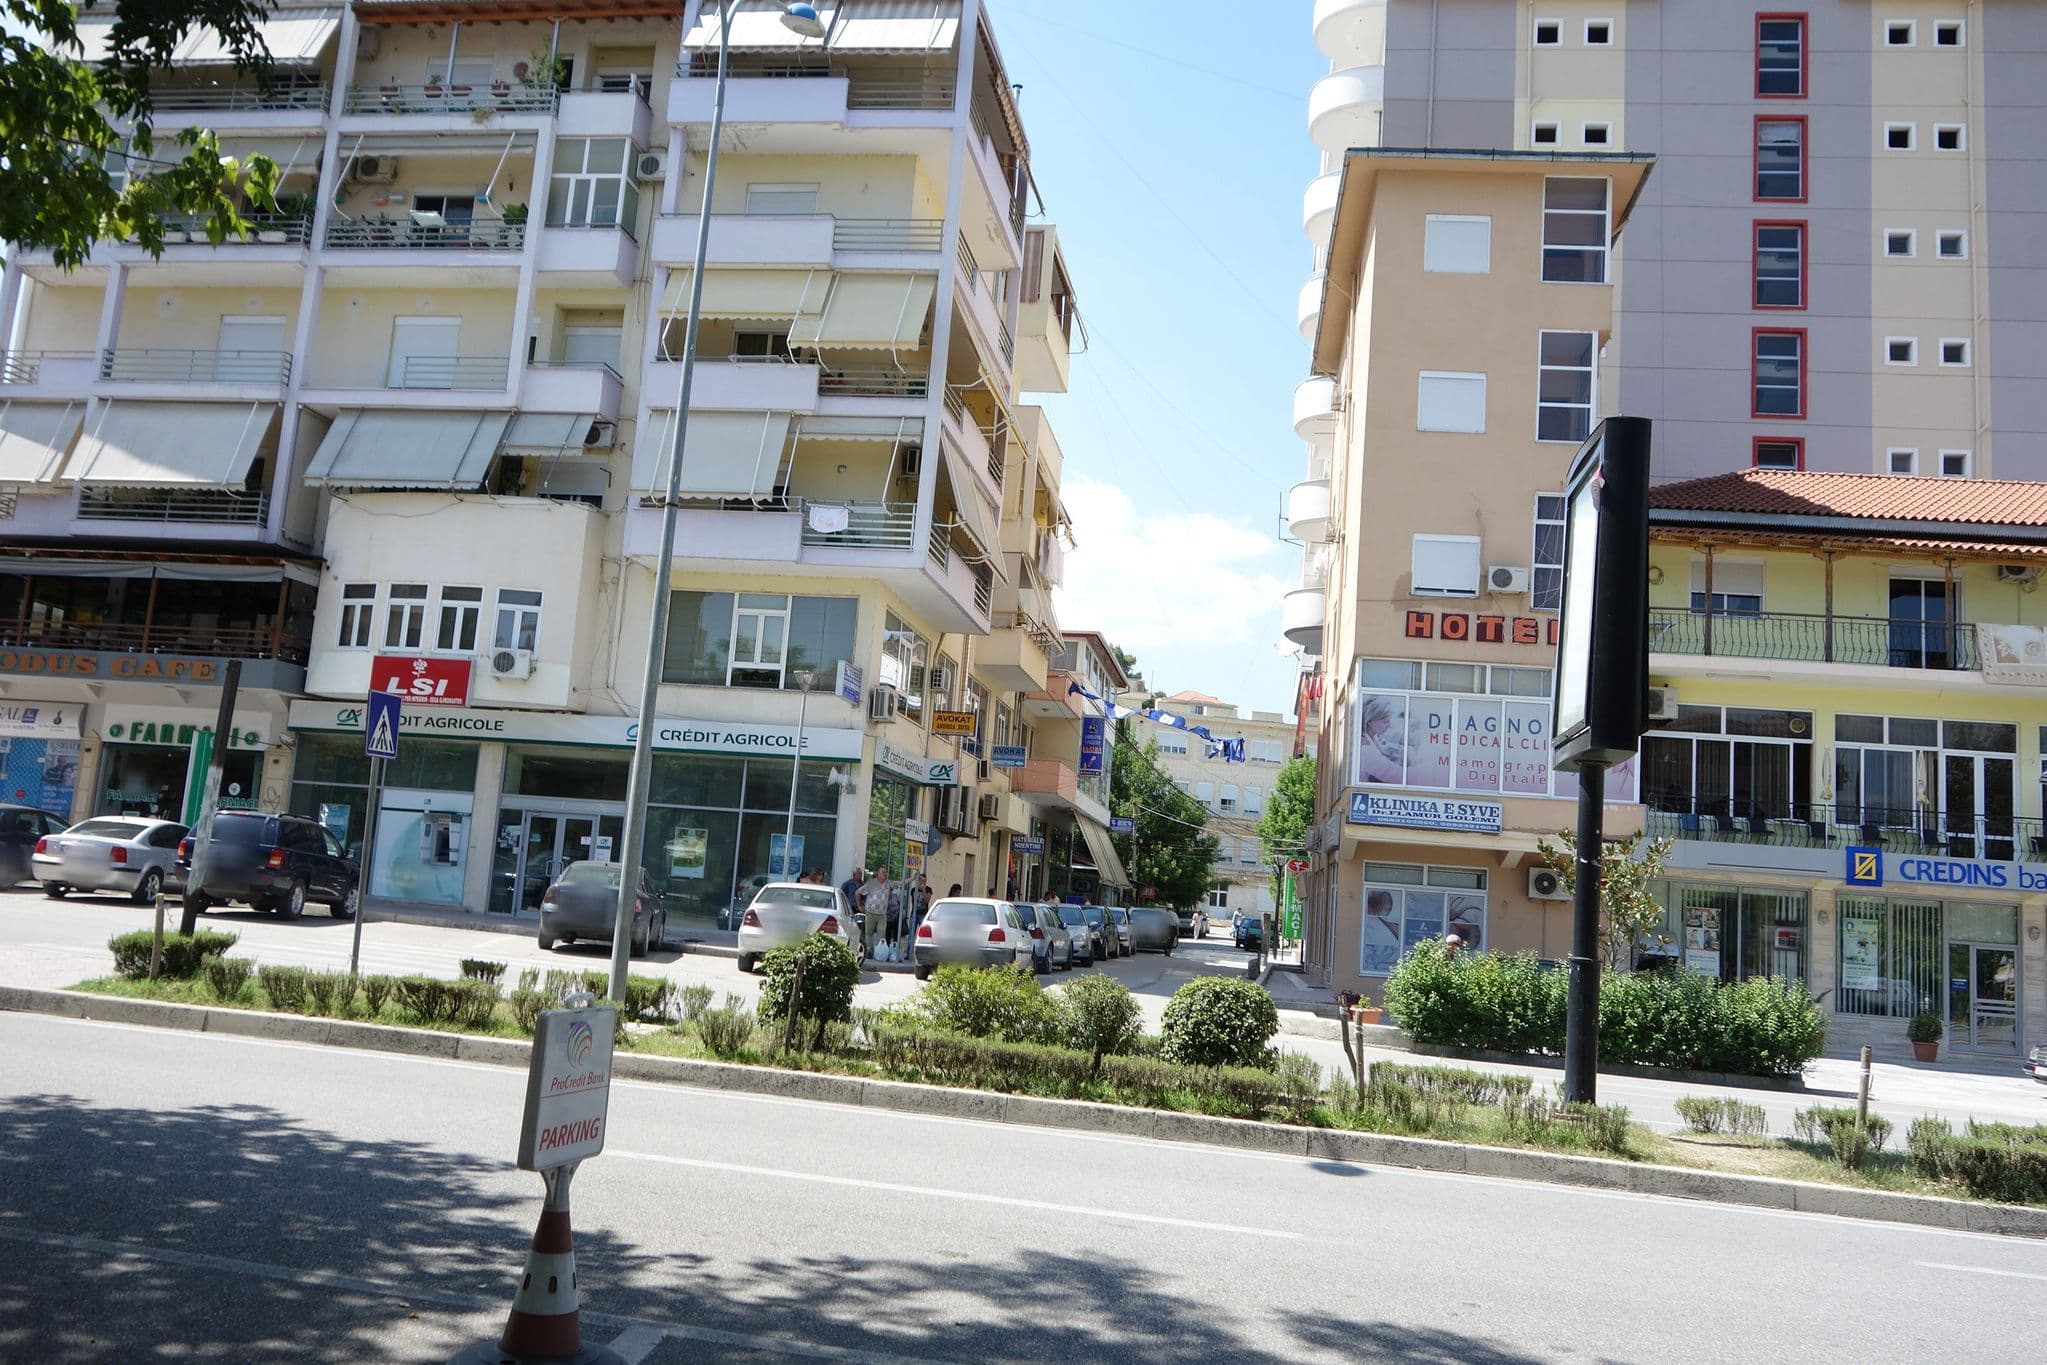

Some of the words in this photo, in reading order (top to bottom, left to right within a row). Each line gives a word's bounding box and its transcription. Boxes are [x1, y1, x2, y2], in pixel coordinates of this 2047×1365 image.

[1407, 612, 1559, 645] HOTE
[111, 656, 217, 680] CAFE
[386, 676, 449, 696] LSI
[424, 717, 504, 732] AGRICOLE
[935, 714, 972, 723] AVOKAT
[129, 721, 240, 748] FARMI
[660, 728, 721, 743] CRÉDIT
[723, 731, 809, 749] AGRICOLE
[1429, 732, 1514, 750] MEDICAL
[1369, 797, 1439, 813] KLINIKA
[1444, 803, 1455, 814] E
[1457, 803, 1500, 818] SYVE
[1445, 814, 1497, 824] GOLEMI
[1899, 859, 2008, 887] CREDINS
[550, 1074, 586, 1092] ProCredit
[587, 1070, 605, 1086] Bank
[538, 1117, 602, 1152] PARKING
